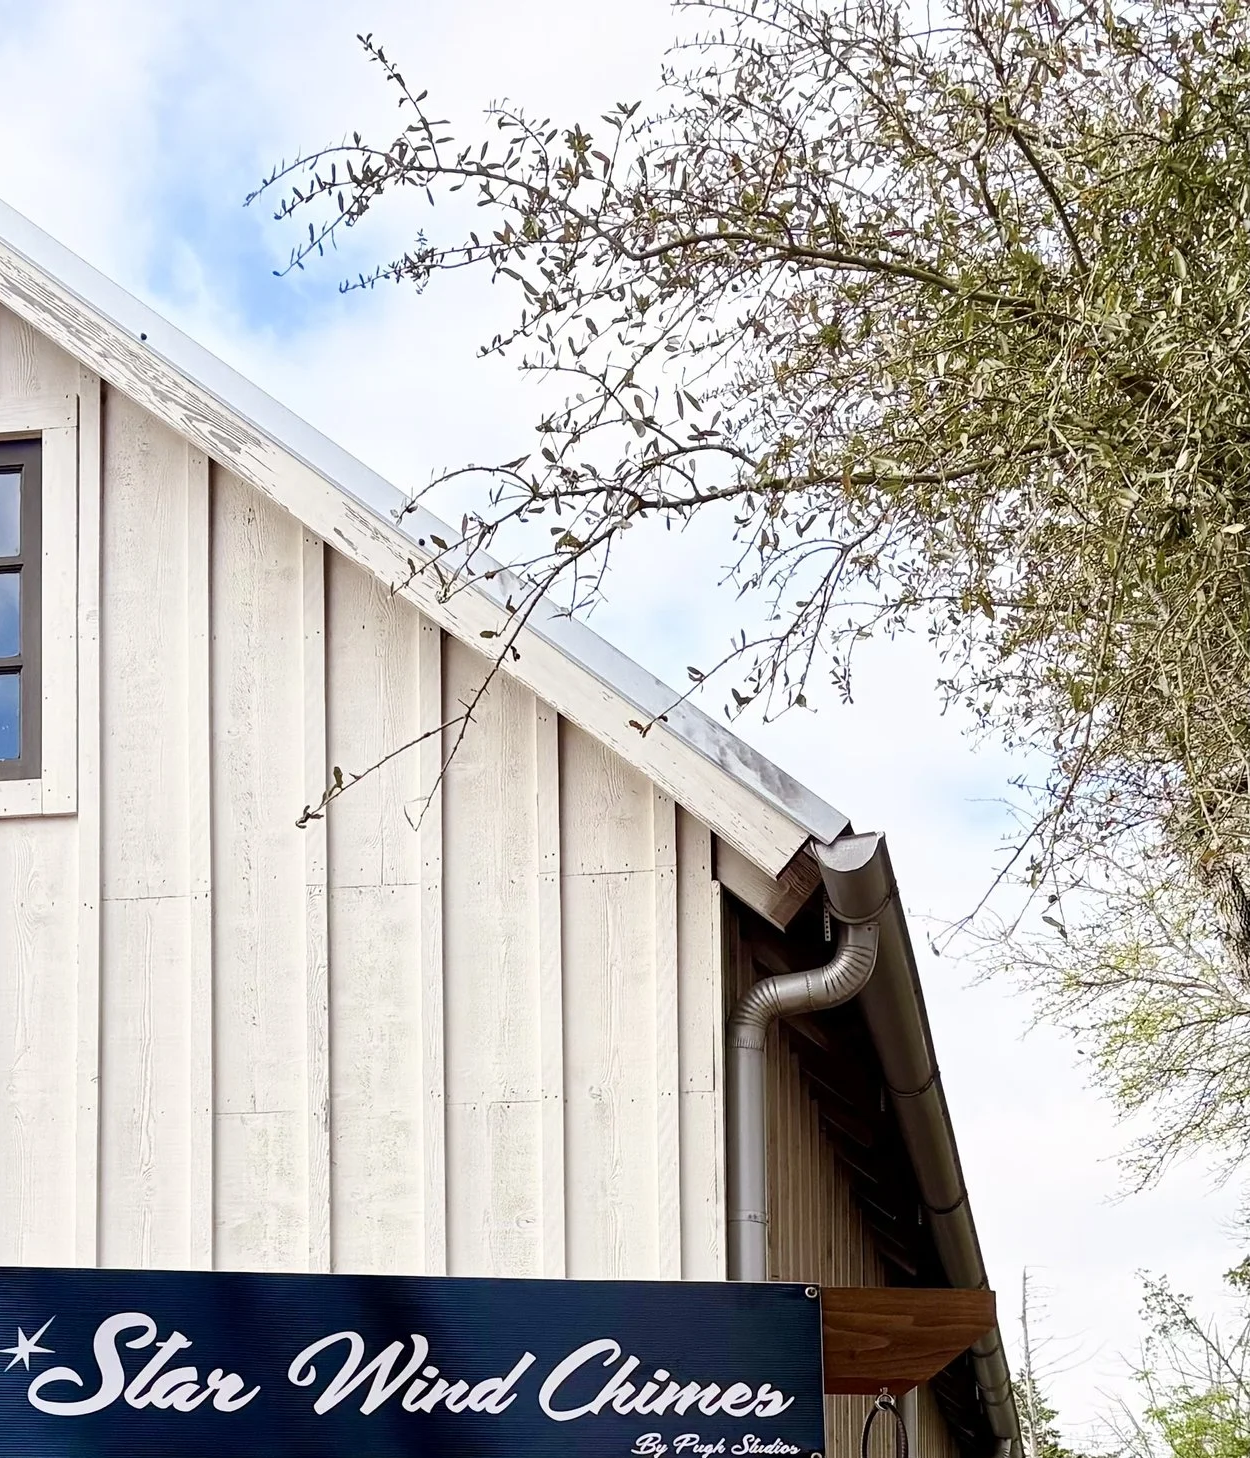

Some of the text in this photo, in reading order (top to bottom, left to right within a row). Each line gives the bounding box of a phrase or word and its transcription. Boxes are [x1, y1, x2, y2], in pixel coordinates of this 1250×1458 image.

[27, 1312, 261, 1416] Star
[288, 1330, 537, 1415] Wind
[538, 1338, 796, 1421] Chimes
[630, 1432, 801, 1458] By Pugh Studios
